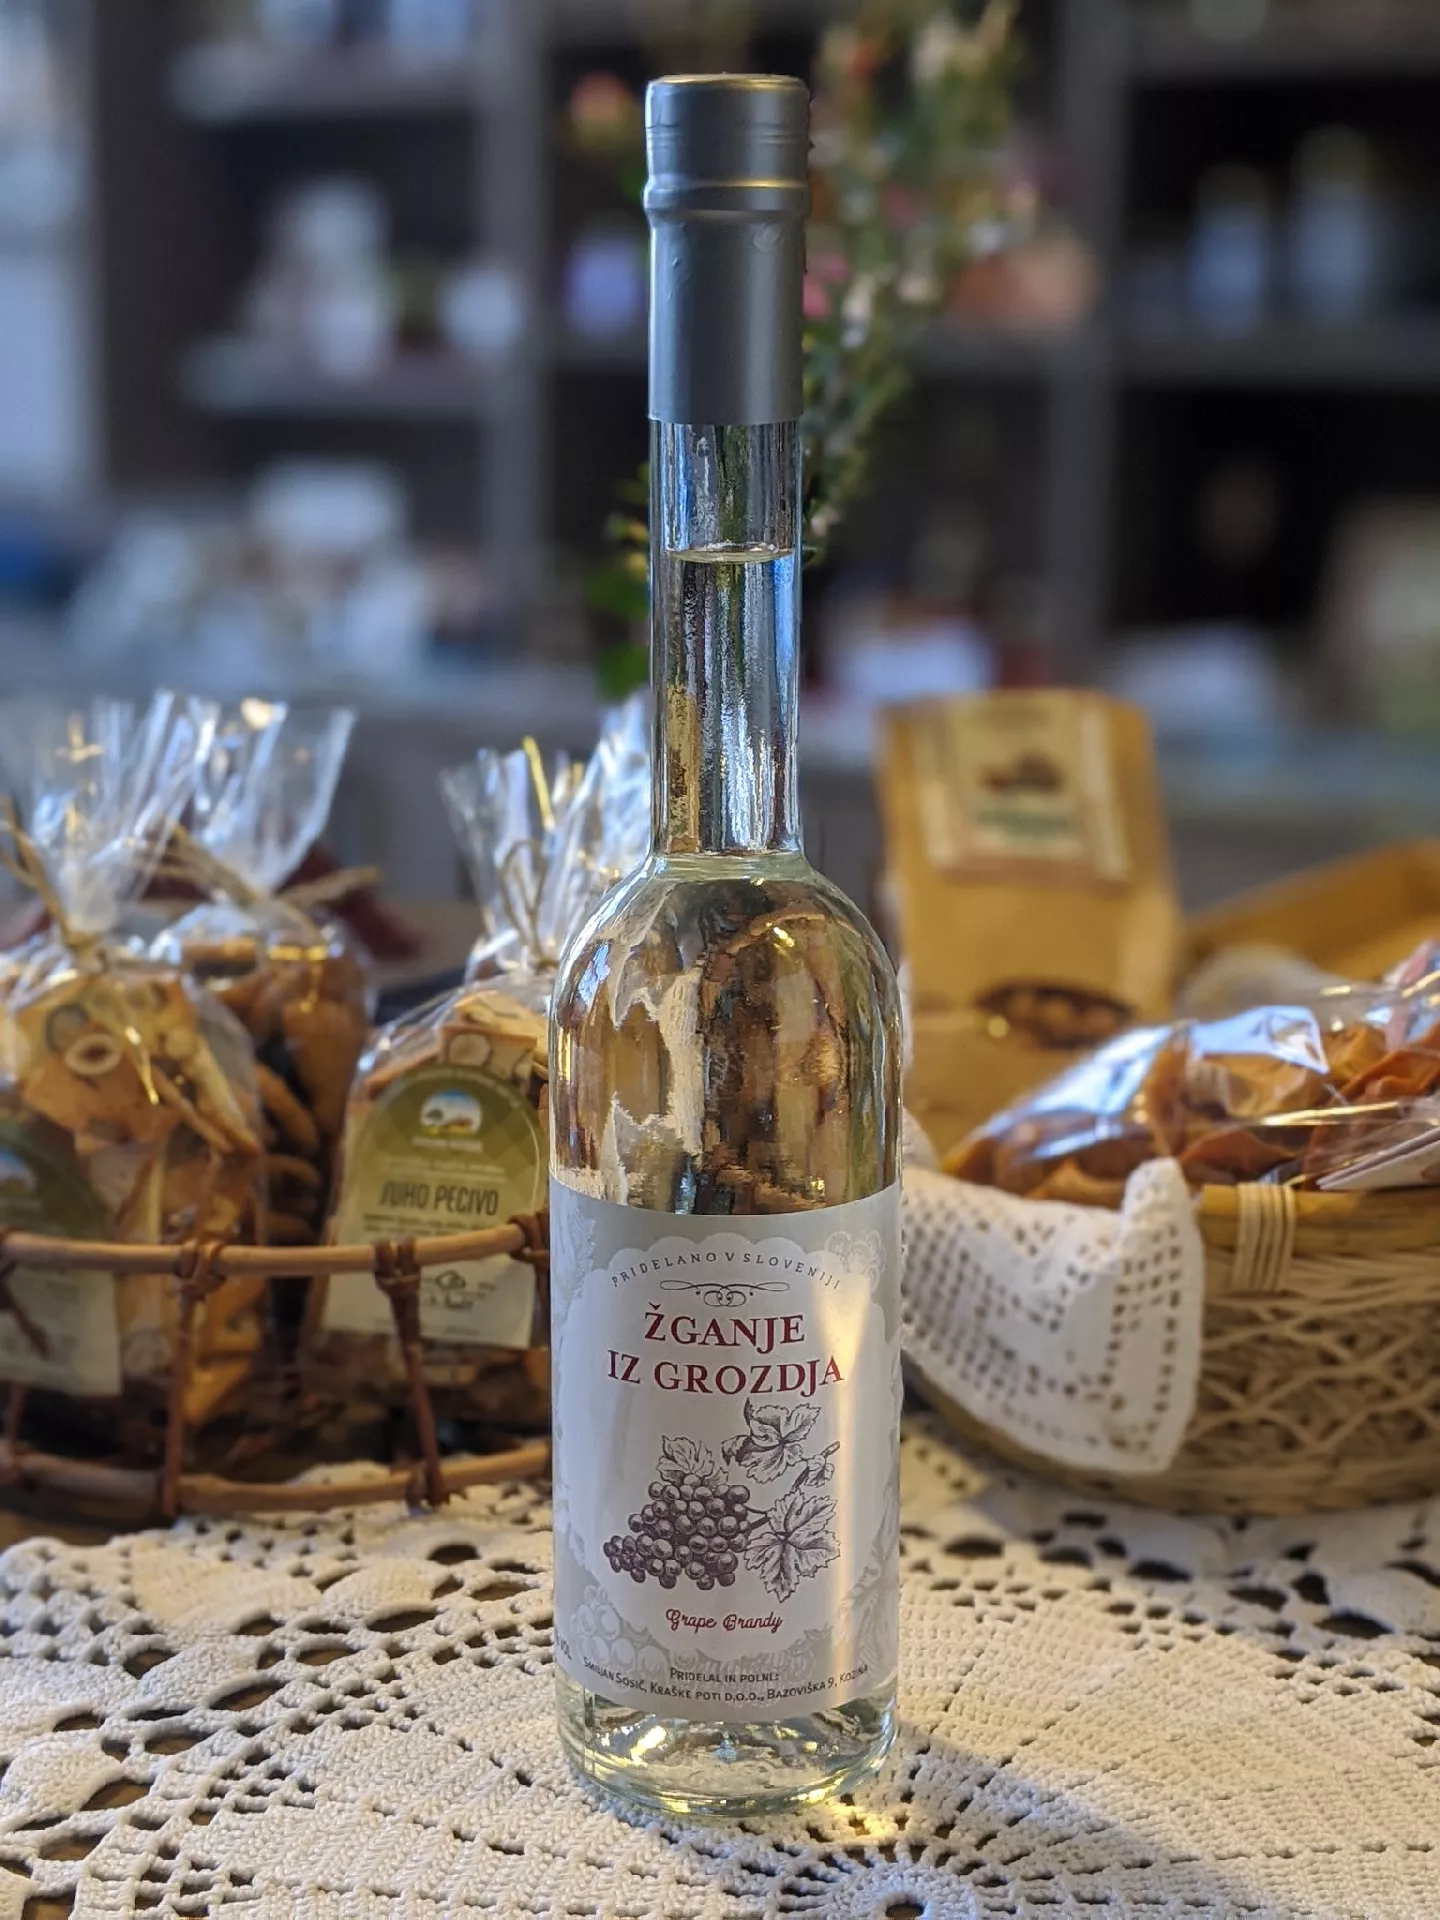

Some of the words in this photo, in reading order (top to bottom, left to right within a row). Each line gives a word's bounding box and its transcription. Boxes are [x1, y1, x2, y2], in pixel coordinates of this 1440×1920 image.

[611, 1252, 717, 1288] PRIDELANO
[725, 1252, 735, 1262] V
[743, 1253, 841, 1289] SLOVENIJI
[644, 1302, 805, 1354] ŽGANJE
[607, 1350, 641, 1384] IZ
[654, 1355, 845, 1397] GROZDJA
[665, 1608, 717, 1635] Grape
[650, 1680, 691, 1699] KRAŠKE
[695, 1691, 721, 1701] POTI
[767, 1682, 826, 1700] BAZOVIŠKA
[670, 1667, 721, 1683] PRIDELAL
[725, 1675, 736, 1683] IN
